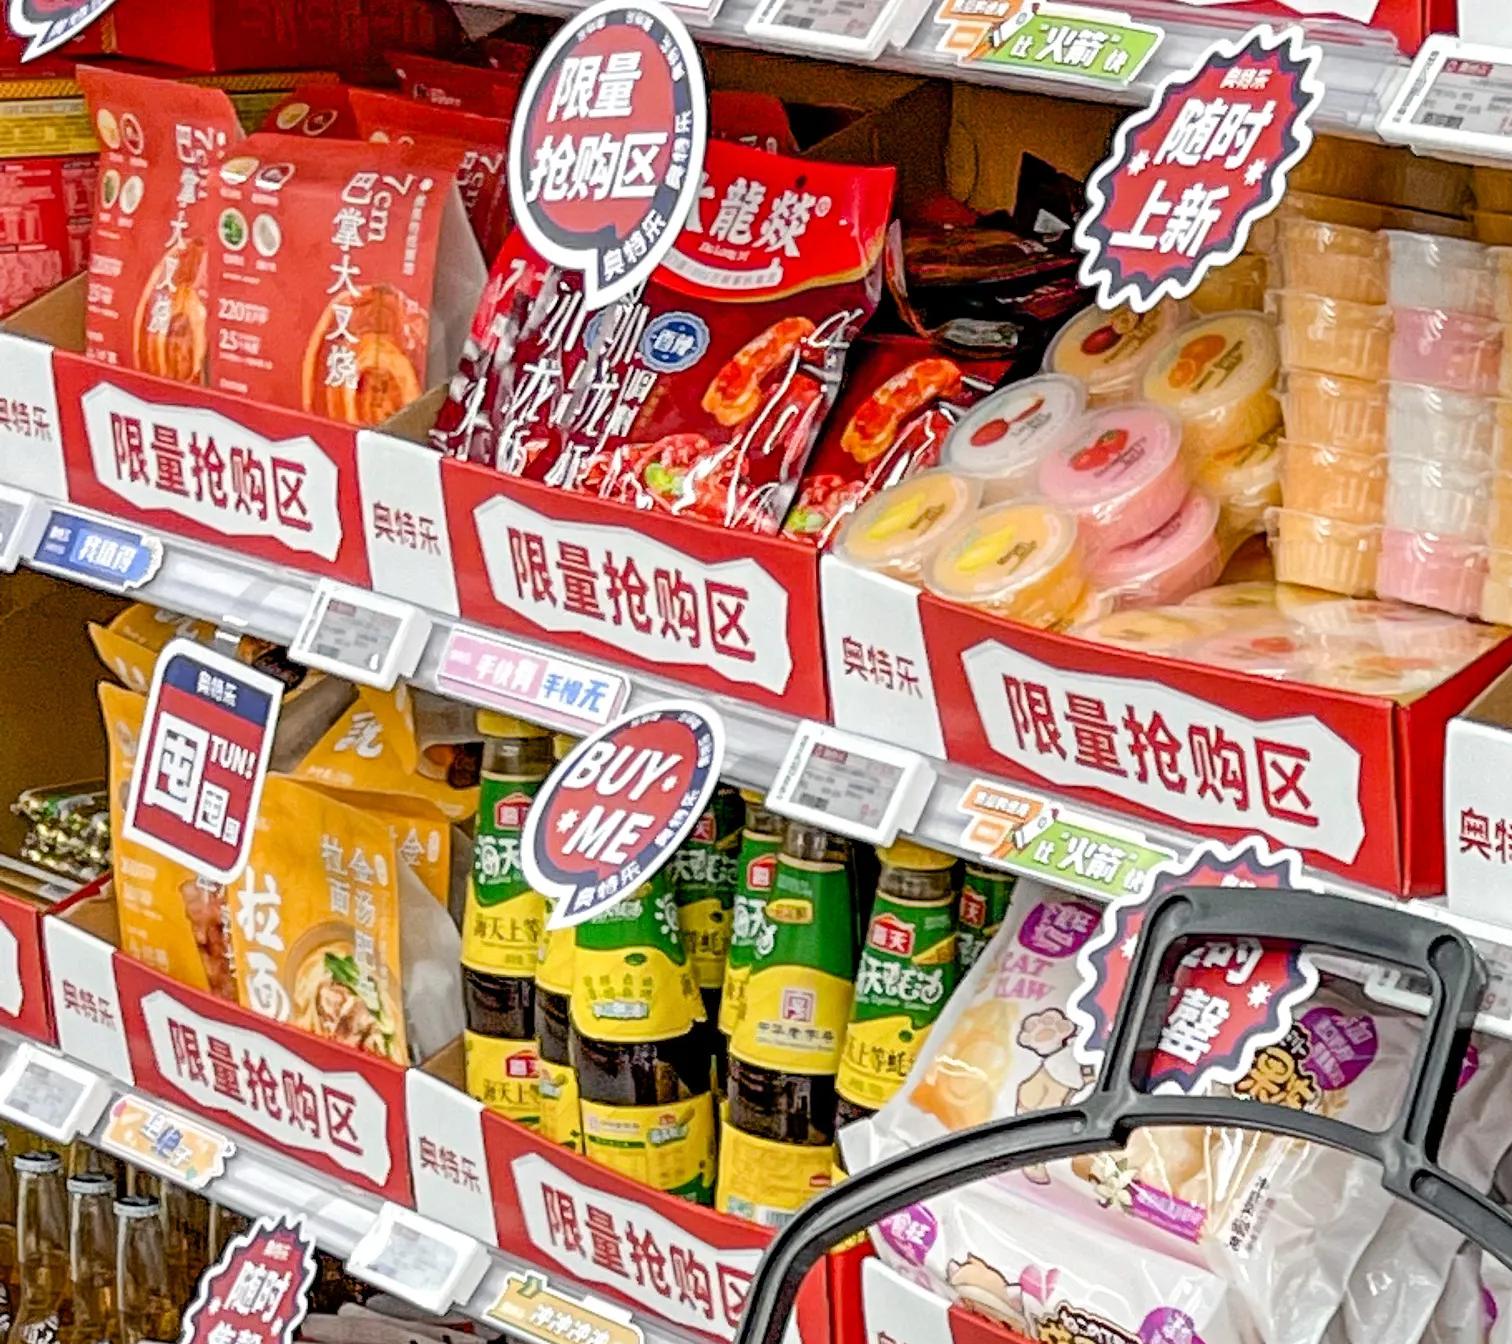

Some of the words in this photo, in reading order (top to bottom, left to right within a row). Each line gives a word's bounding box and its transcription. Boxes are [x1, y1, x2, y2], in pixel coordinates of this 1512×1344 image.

[546, 50, 643, 122] 限量
[526, 131, 668, 203] 抢购区
[1153, 98, 1279, 171] 随时
[601, 209, 667, 281] 奥特乐
[1108, 181, 1231, 259] 上新
[325, 172, 377, 390] 巴掌大叉烧
[110, 412, 314, 532] 限量抢购区
[372, 502, 443, 555] 奥特乐
[507, 527, 757, 663] 限量抢购区
[841, 635, 924, 699] 奥特乐
[210, 733, 258, 779] TUN!
[562, 740, 683, 801] BUY
[1004, 672, 1321, 830] 限量抢购区
[561, 805, 655, 866] ME
[62, 979, 117, 1032] 奥特乐
[168, 1017, 364, 1157] 限量抢购区
[418, 1135, 484, 1195] 奥特乐
[222, 1261, 292, 1323] 随时
[540, 1182, 754, 1330] 限量抢购区
